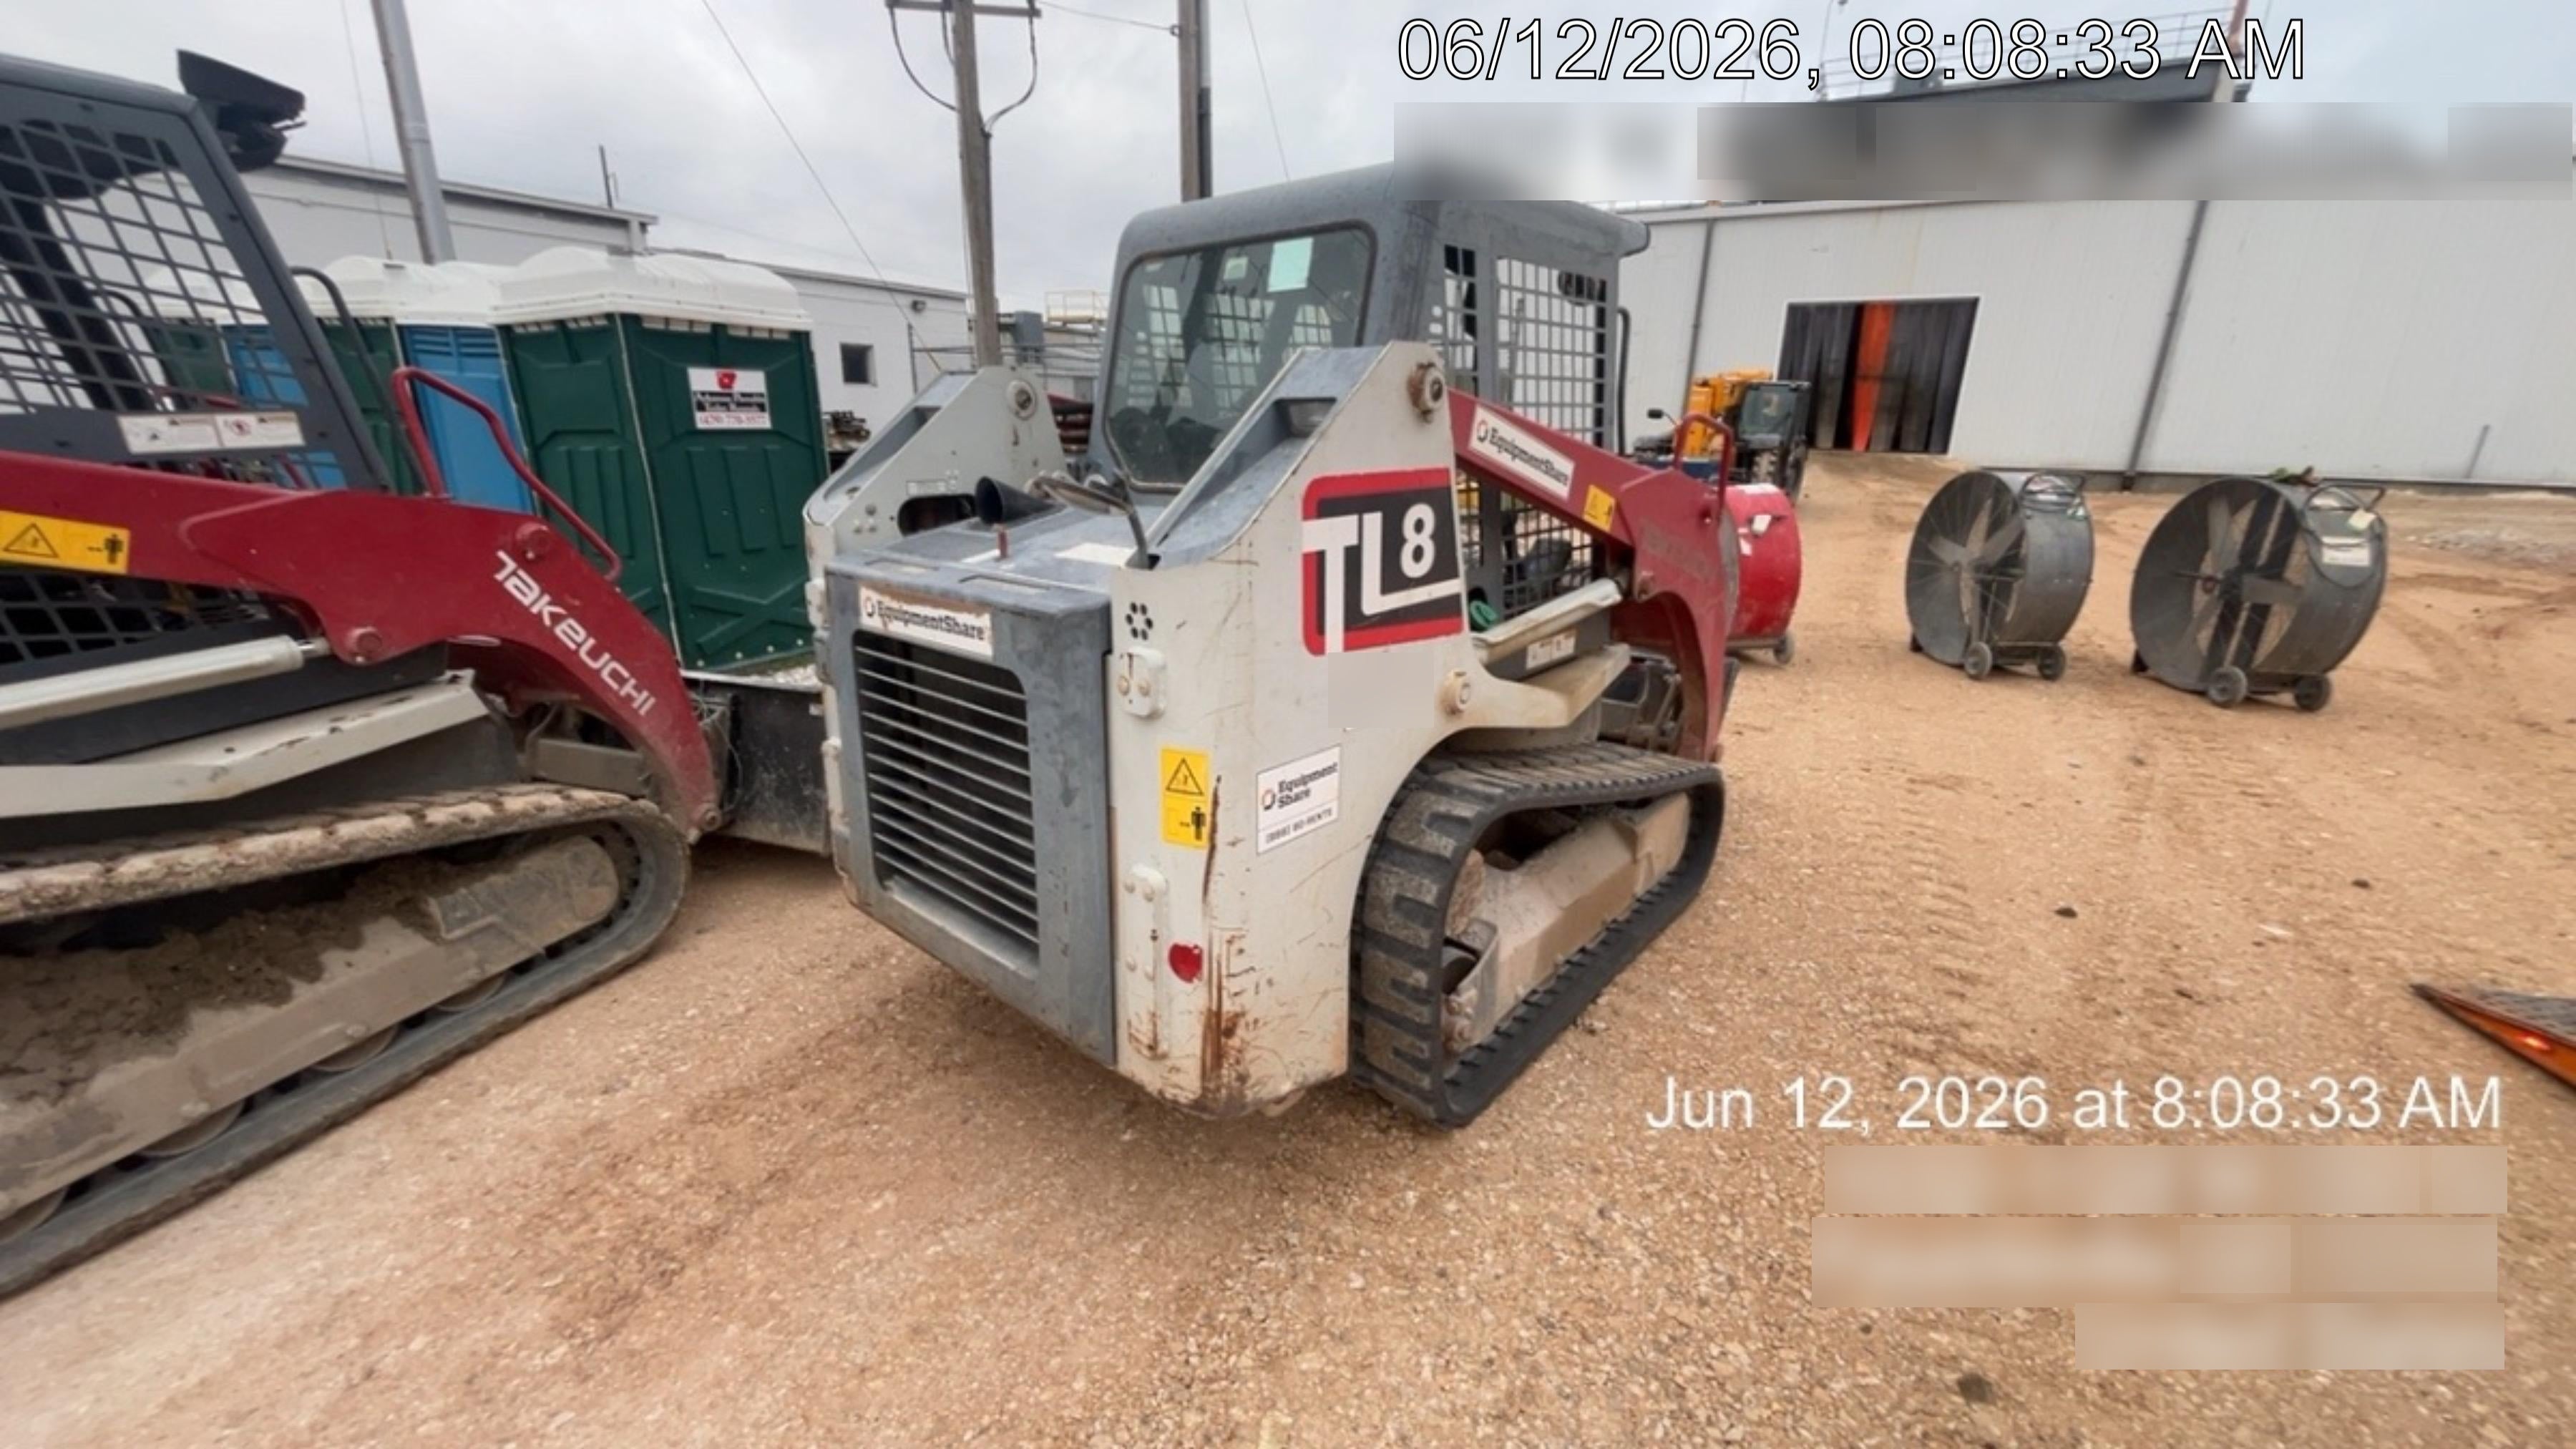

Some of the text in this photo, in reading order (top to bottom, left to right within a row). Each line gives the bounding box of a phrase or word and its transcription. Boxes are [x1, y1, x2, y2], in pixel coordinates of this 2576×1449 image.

[1489, 427, 1568, 487] EquipmentShare
[1302, 503, 1461, 653] TL8
[877, 600, 985, 640] EquipmentShare
[1278, 761, 1338, 793] Equipment
[1278, 788, 1311, 809] Share
